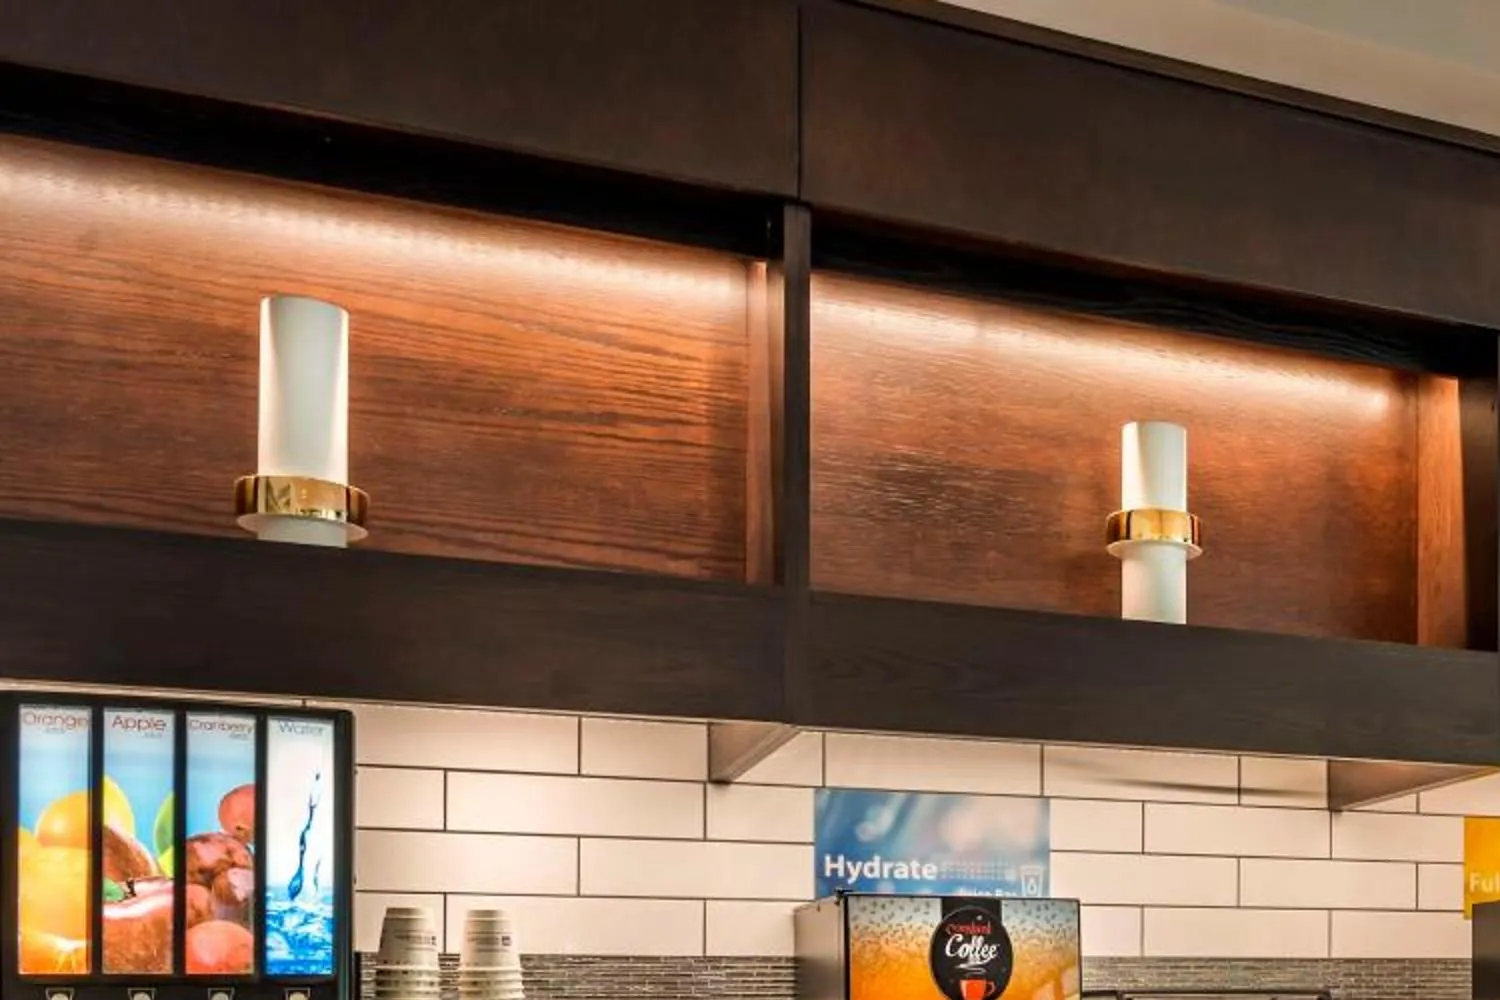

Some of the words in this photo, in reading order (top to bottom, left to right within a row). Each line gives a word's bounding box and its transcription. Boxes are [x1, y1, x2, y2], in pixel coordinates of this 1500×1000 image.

[23, 710, 89, 729] Orange
[112, 714, 167, 731] Apple
[278, 719, 324, 736] Water
[824, 854, 938, 884] Hydrate
[945, 934, 1000, 963] Coffee
